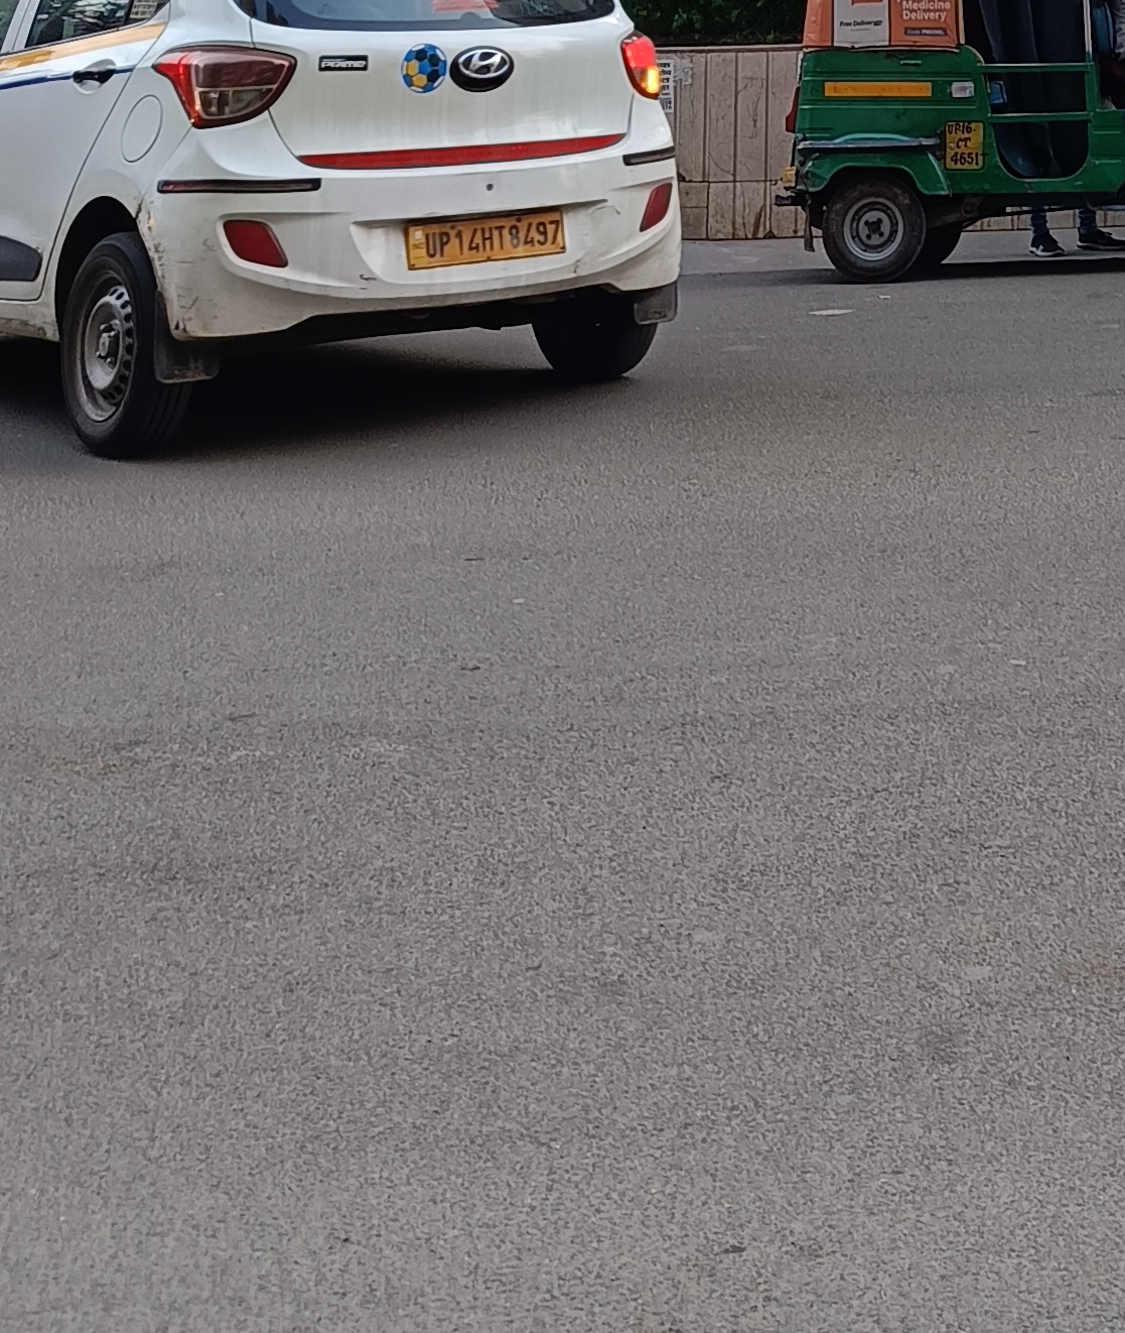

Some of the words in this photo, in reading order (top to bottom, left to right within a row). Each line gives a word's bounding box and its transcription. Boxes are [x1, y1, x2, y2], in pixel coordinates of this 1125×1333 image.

[902, 0, 951, 10] Medicine
[902, 10, 947, 22] Delivery
[956, 136, 972, 150] CT
[950, 152, 980, 166] 4651
[425, 219, 561, 259] UP14HT8497
